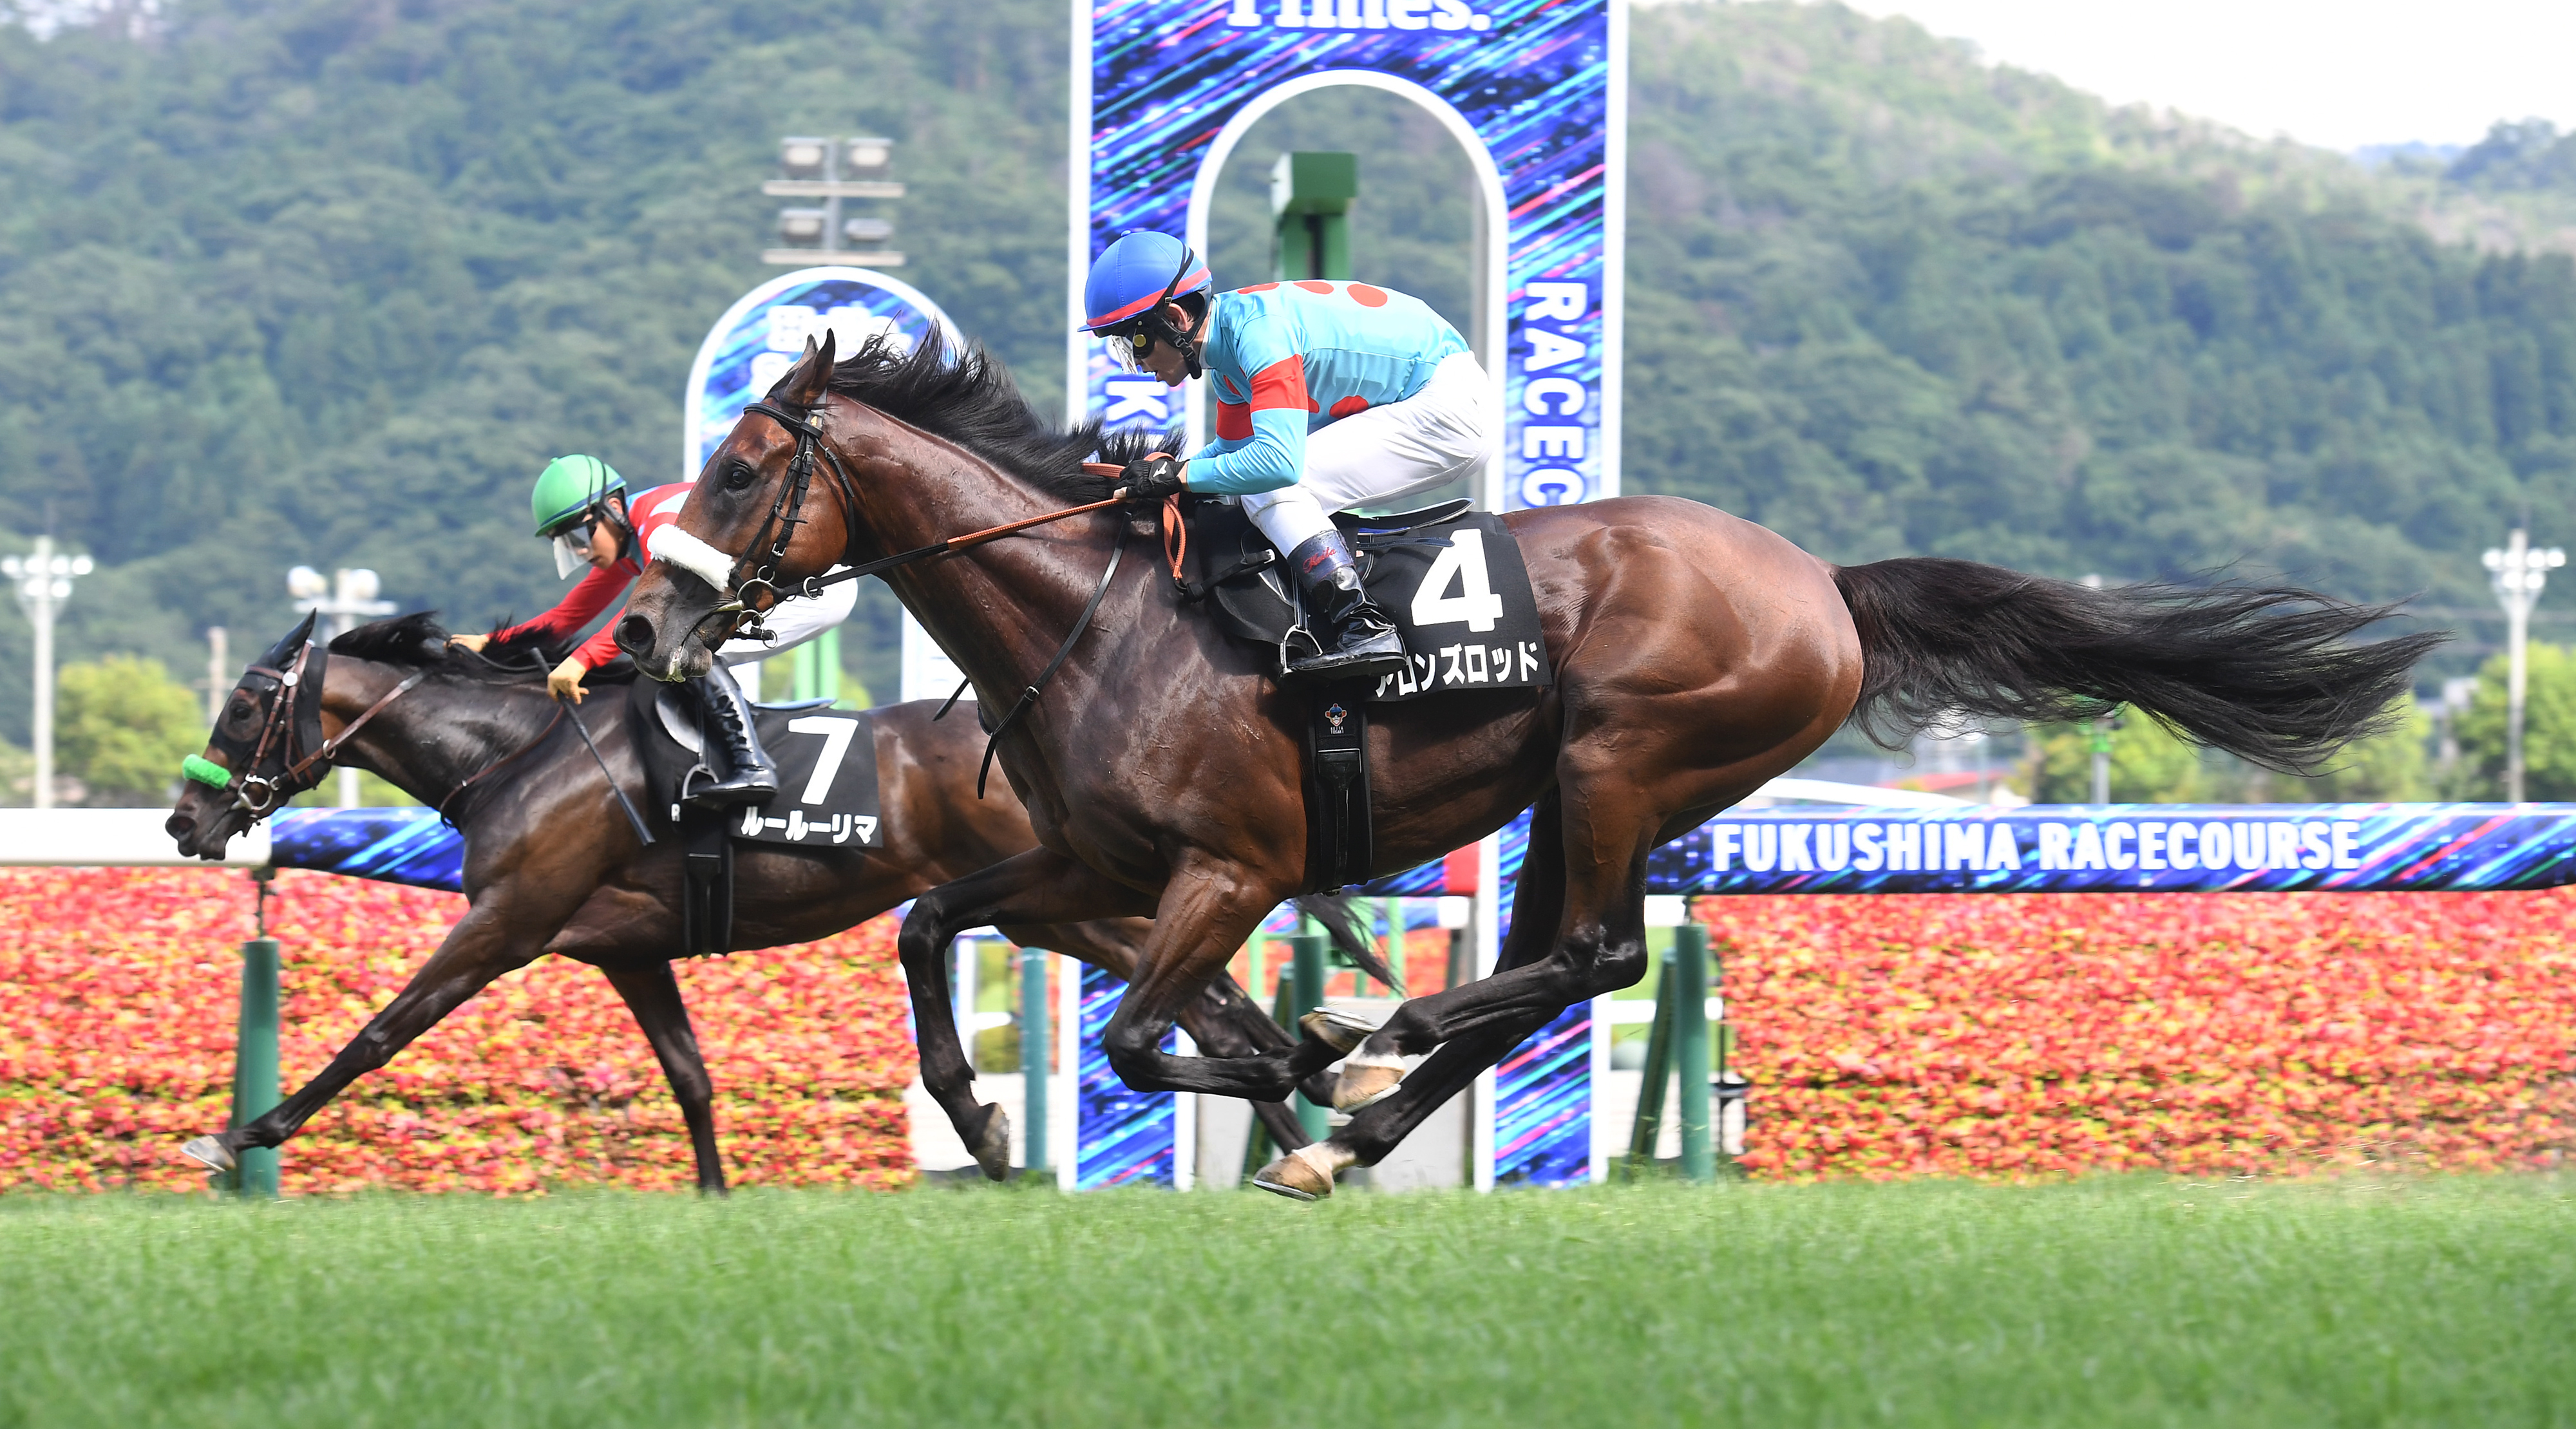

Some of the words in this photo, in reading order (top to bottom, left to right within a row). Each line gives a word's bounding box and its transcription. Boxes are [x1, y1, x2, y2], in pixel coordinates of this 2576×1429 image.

[1410, 528, 1504, 632] 4
[788, 715, 858, 805] 7
[741, 806, 878, 844] ルールーリマ
[1712, 822, 2022, 872] FUKUSHIMA
[2038, 821, 2360, 871] RACECOURSE
